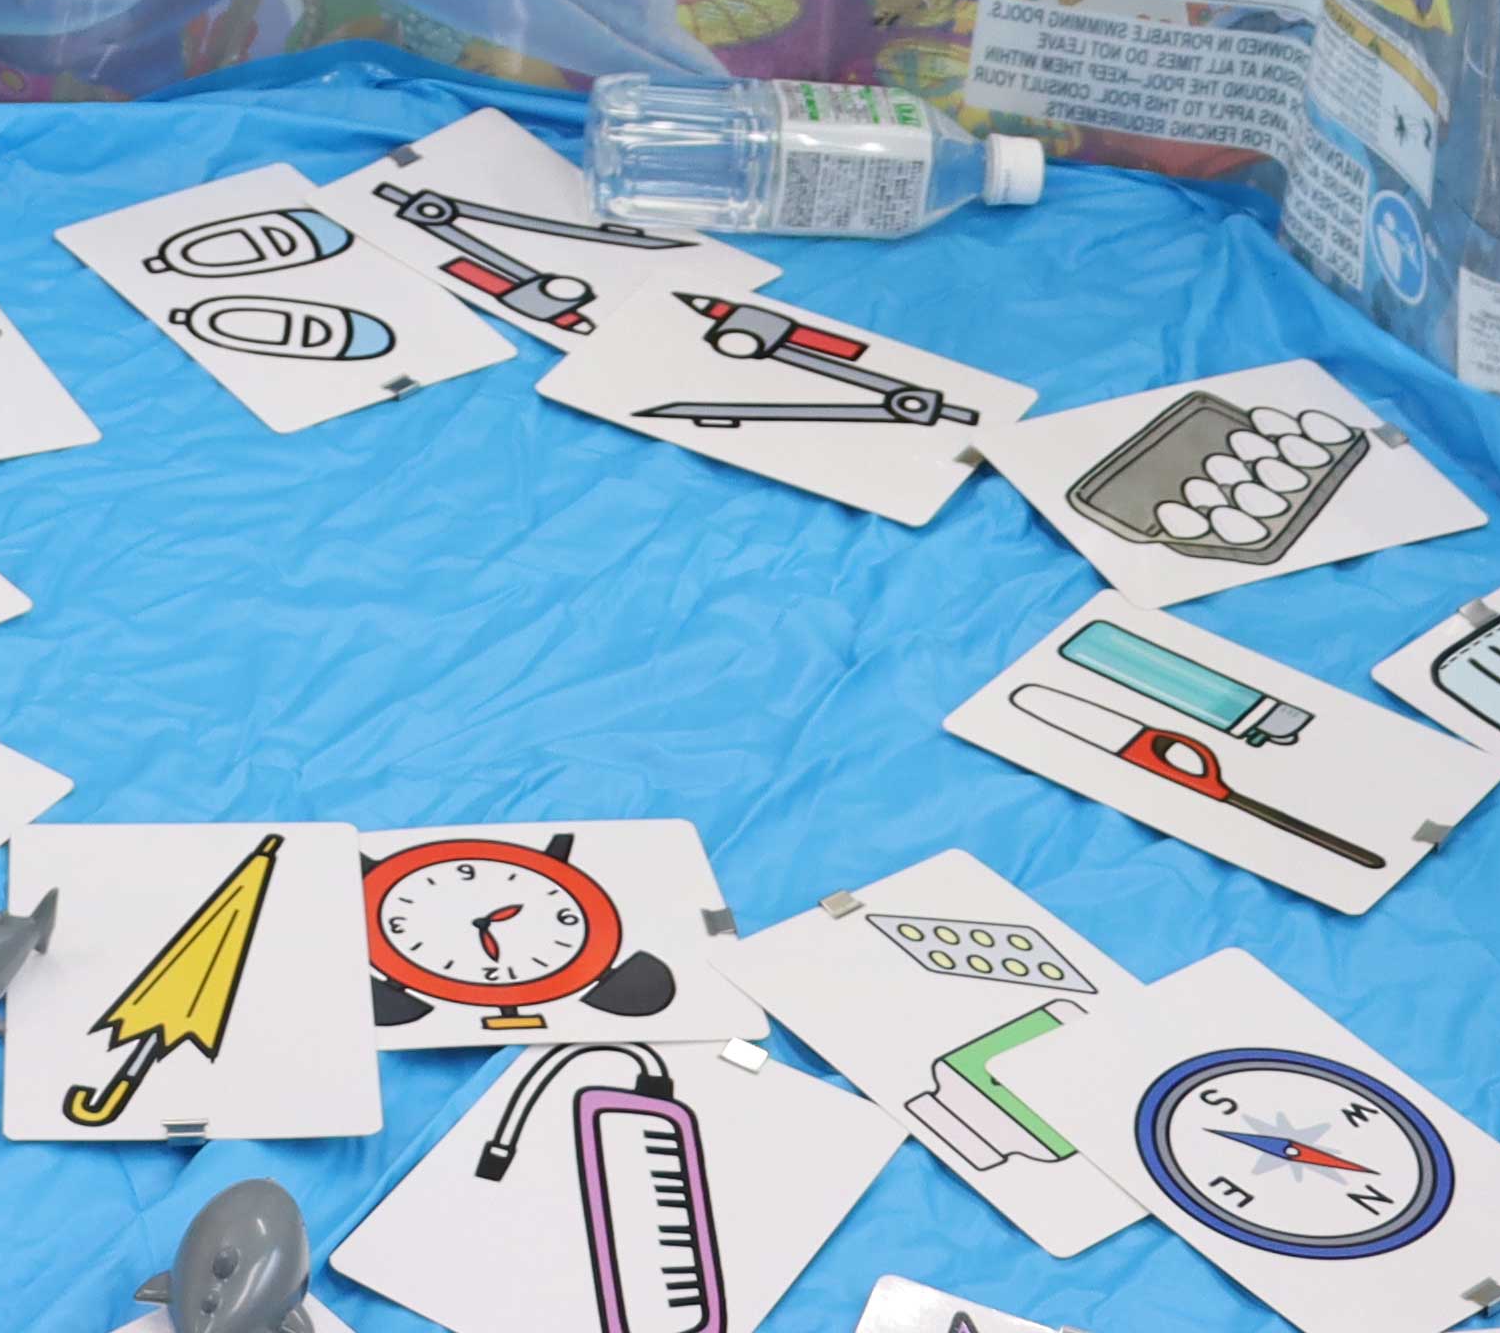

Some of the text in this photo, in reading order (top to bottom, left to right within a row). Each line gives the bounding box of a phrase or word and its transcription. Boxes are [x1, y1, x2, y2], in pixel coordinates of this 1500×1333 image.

[389, 916, 406, 934] 3
[481, 966, 518, 981] 12
[1199, 1088, 1239, 1116] S
[1341, 1102, 1379, 1128] W
[1208, 1176, 1254, 1208] E
[1346, 1184, 1394, 1216] N
